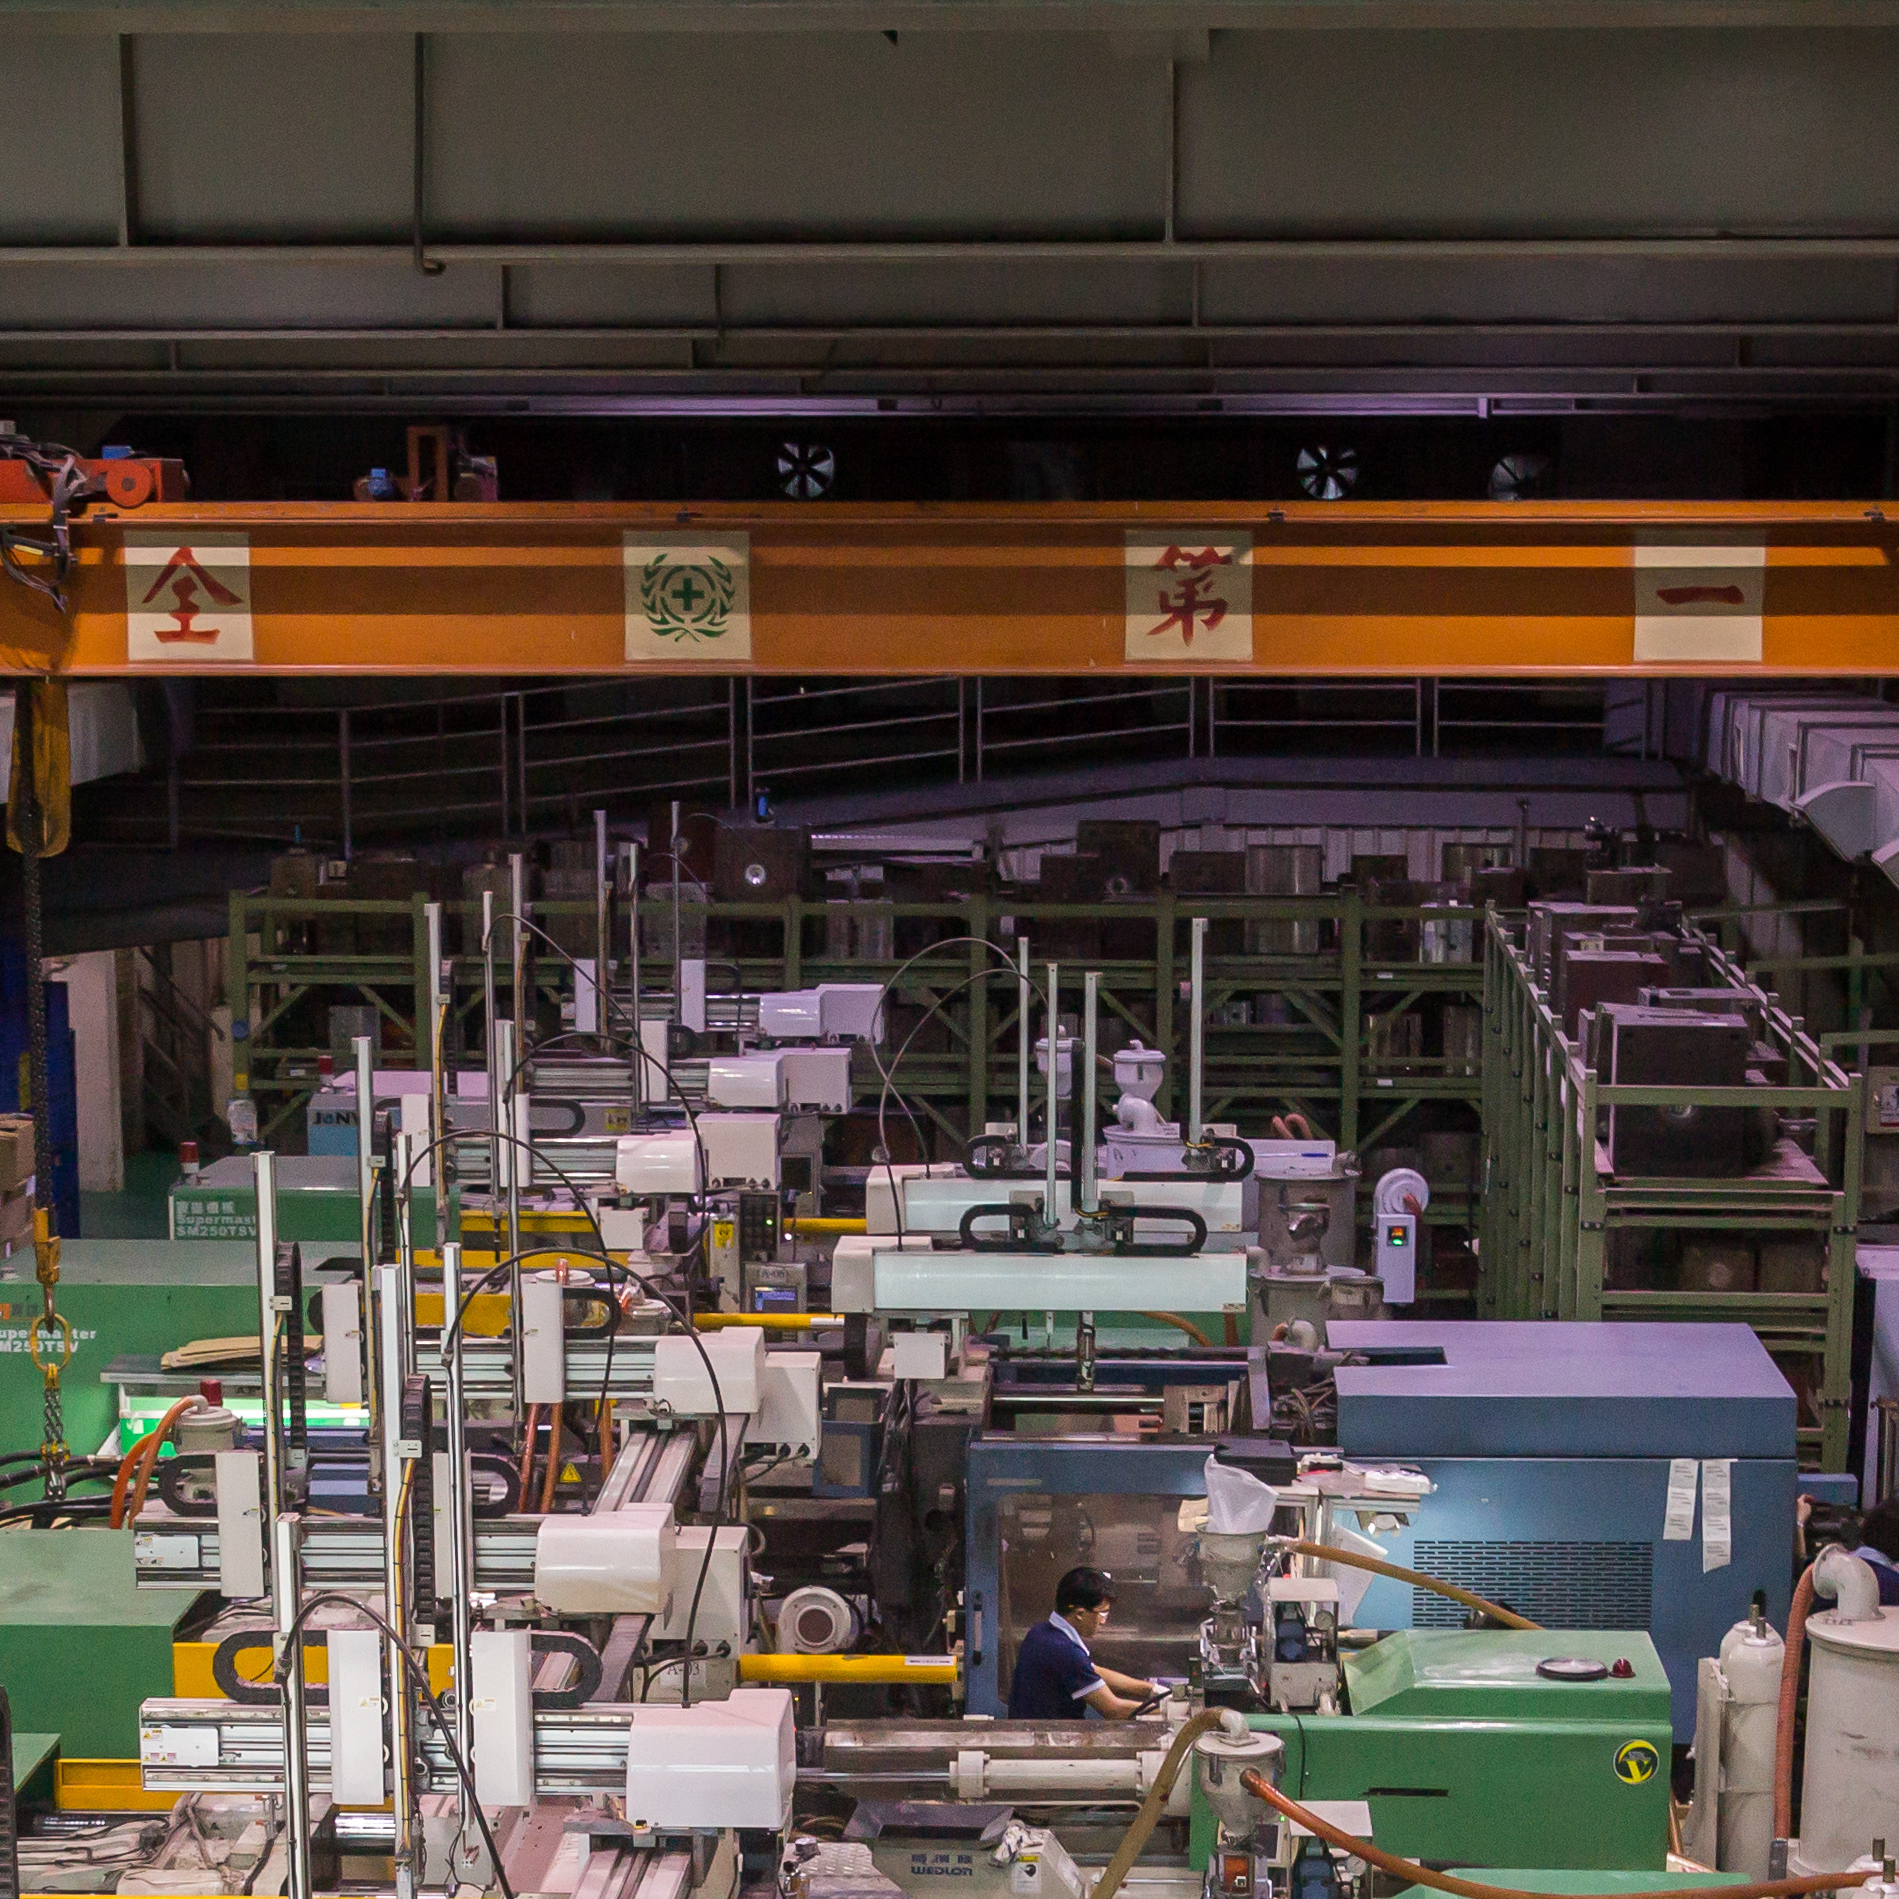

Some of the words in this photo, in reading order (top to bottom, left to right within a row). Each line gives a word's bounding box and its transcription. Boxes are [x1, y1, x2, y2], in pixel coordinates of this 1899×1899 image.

[142, 546, 244, 645] 全
[1147, 544, 1232, 646] 第
[1655, 585, 1745, 605] 一
